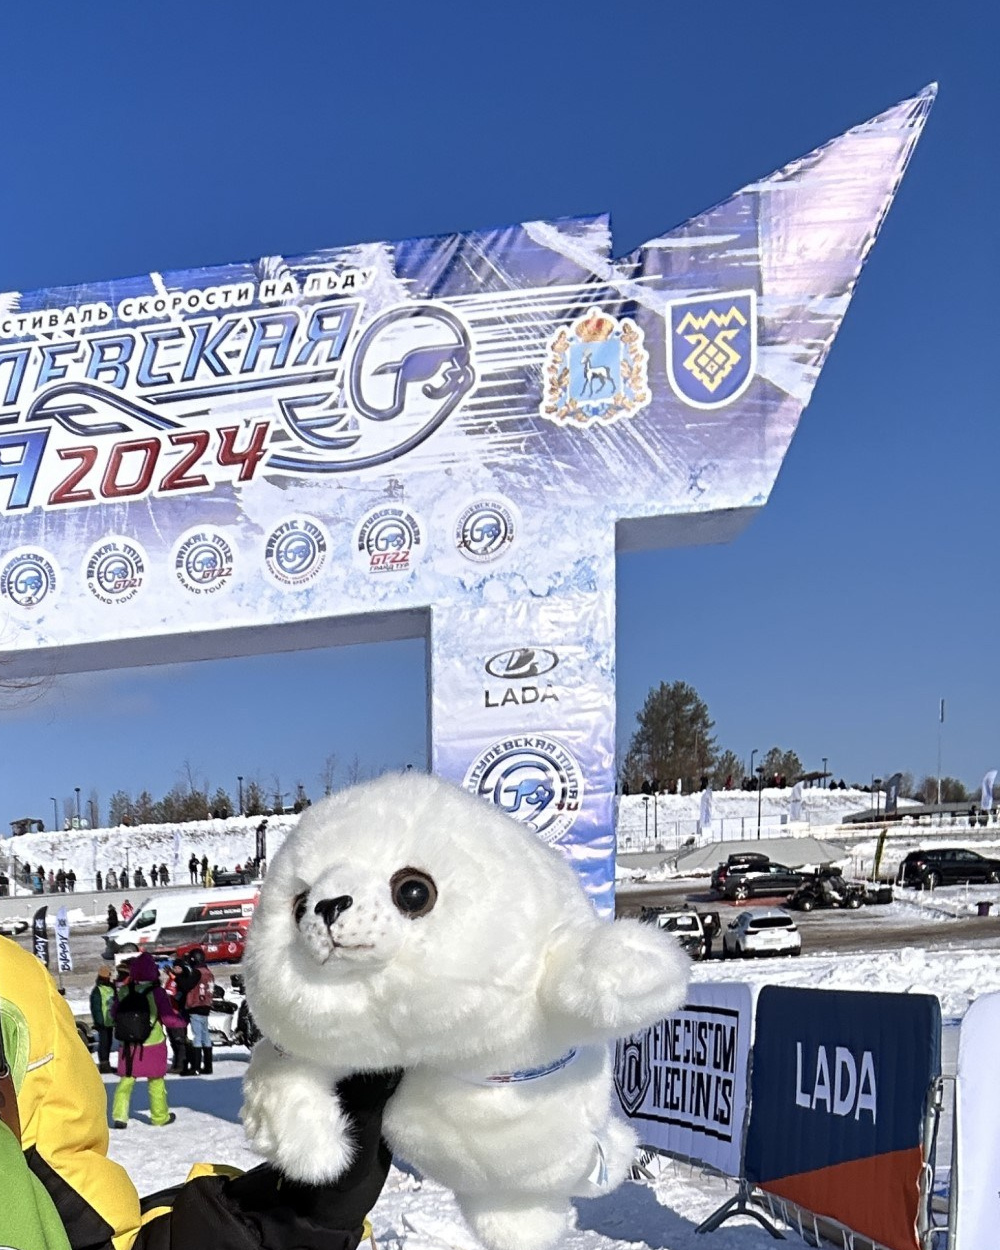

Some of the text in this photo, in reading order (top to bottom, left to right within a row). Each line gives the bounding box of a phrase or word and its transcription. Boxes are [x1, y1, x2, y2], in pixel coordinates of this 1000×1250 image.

[122, 287, 250, 317] СКОРОСТИ
[264, 280, 295, 297] НА
[307, 270, 373, 291] ЛЬДУ
[47, 420, 271, 506] 2024
[176, 572, 227, 595] GRAND TOUR
[484, 684, 560, 708] LADA
[796, 1041, 877, 1126] LADA
